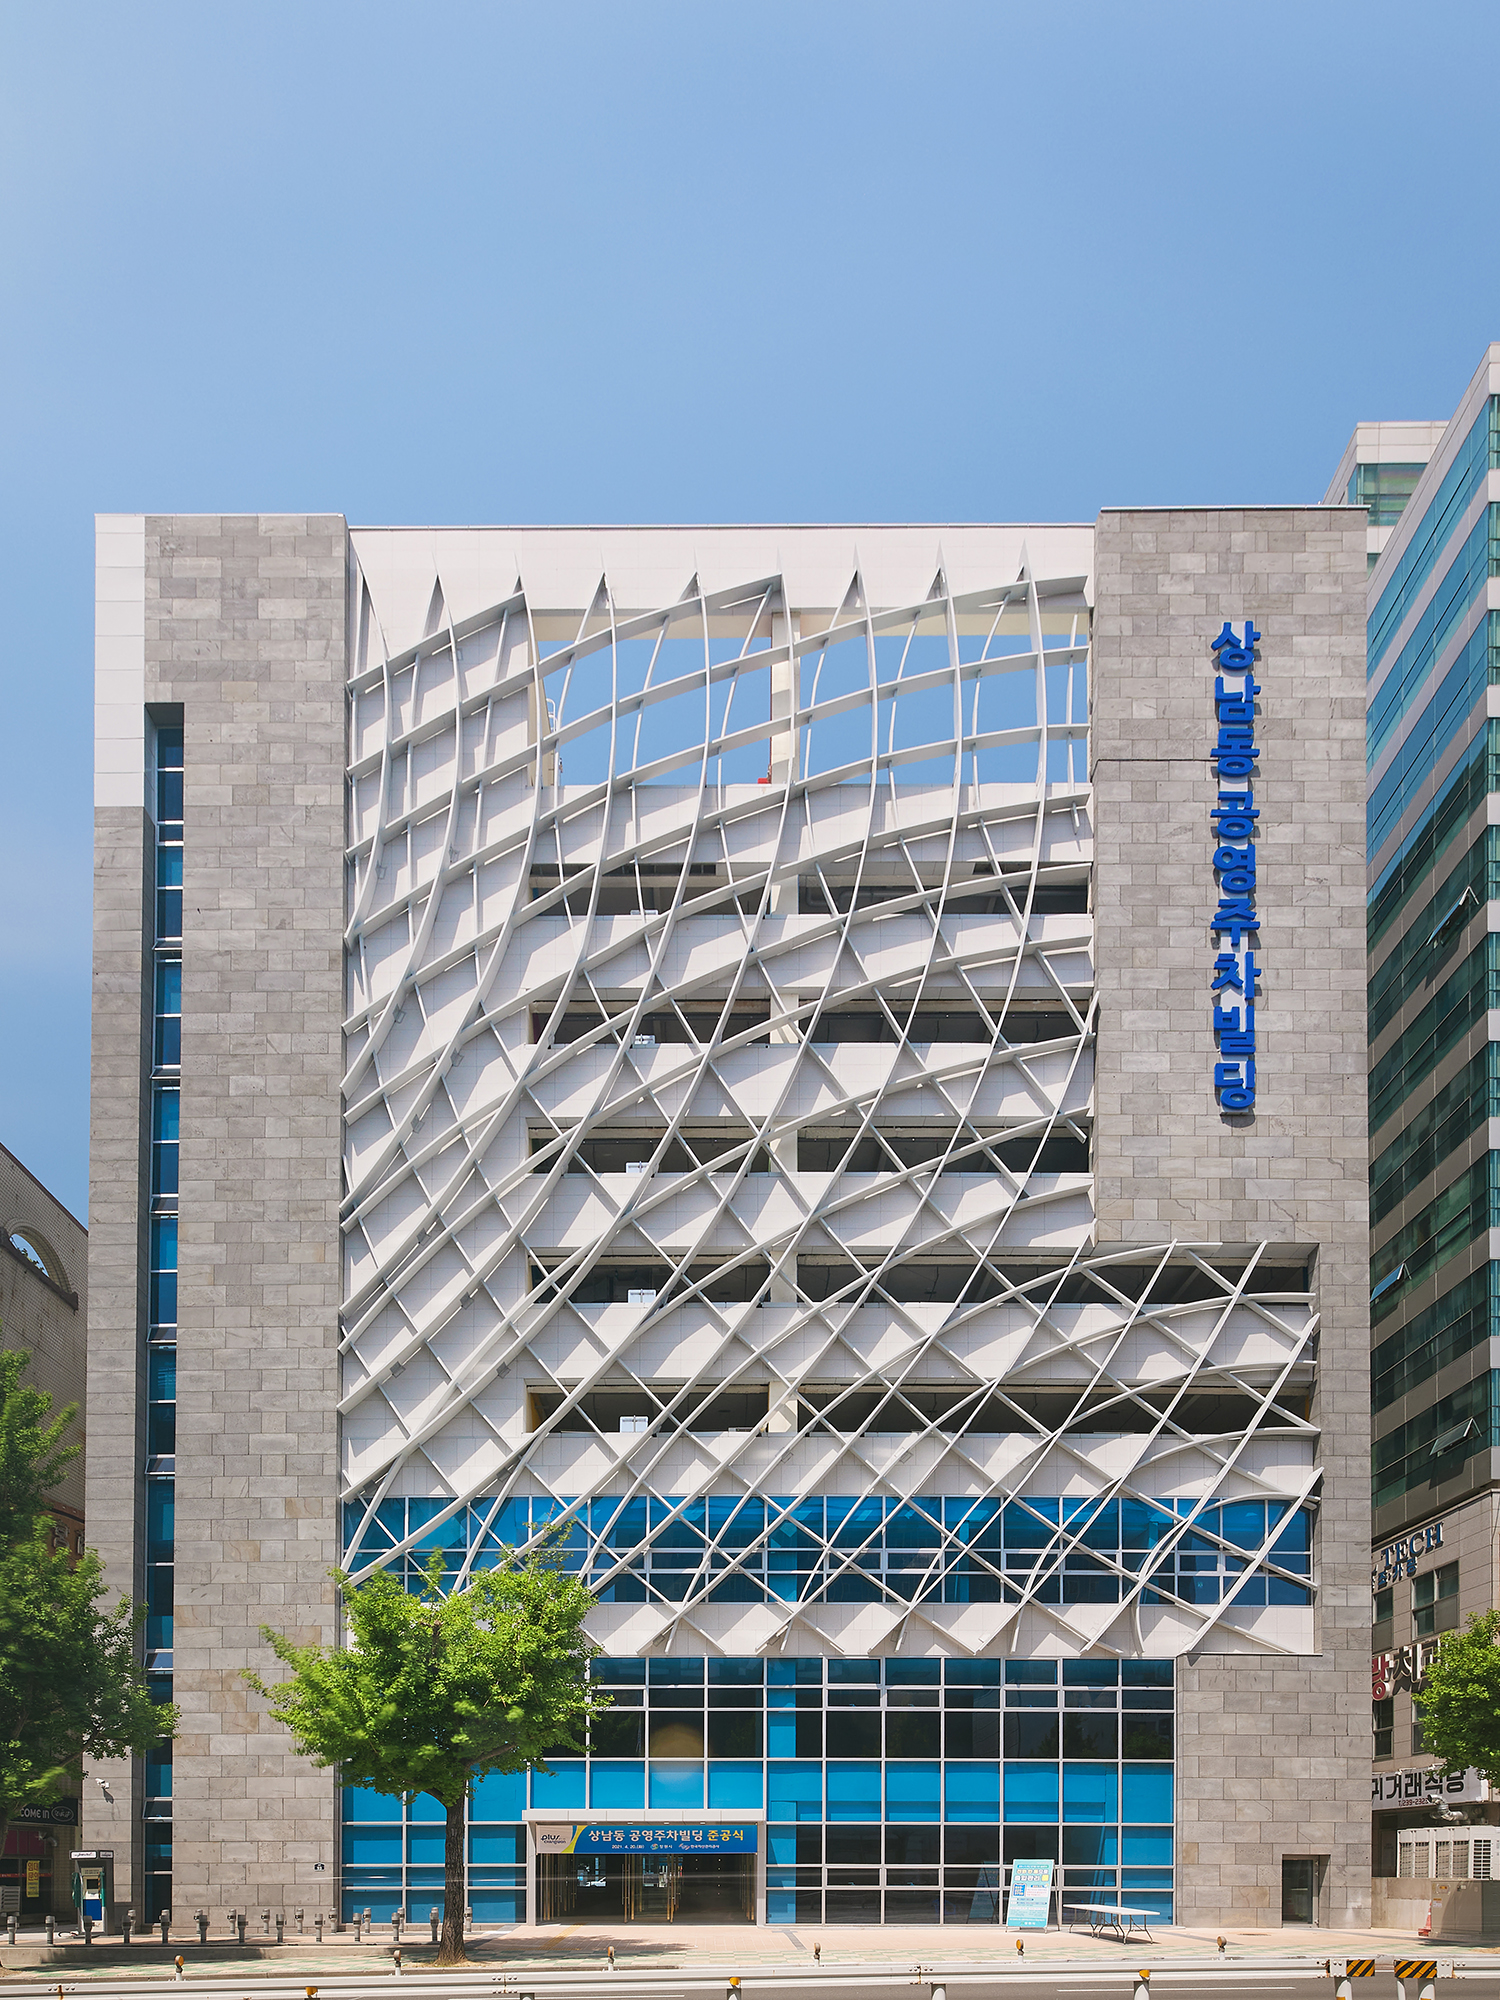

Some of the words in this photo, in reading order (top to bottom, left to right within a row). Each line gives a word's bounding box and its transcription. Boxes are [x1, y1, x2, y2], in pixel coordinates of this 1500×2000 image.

[1210, 620, 1262, 777] 상남동
[1210, 790, 1262, 1112] 공영주차빌딩
[1380, 1521, 1444, 1568] TECH
[588, 1829, 626, 1842] 상남동
[629, 1829, 703, 1842] 공영주차빌딩
[707, 1829, 744, 1842] 준공식
